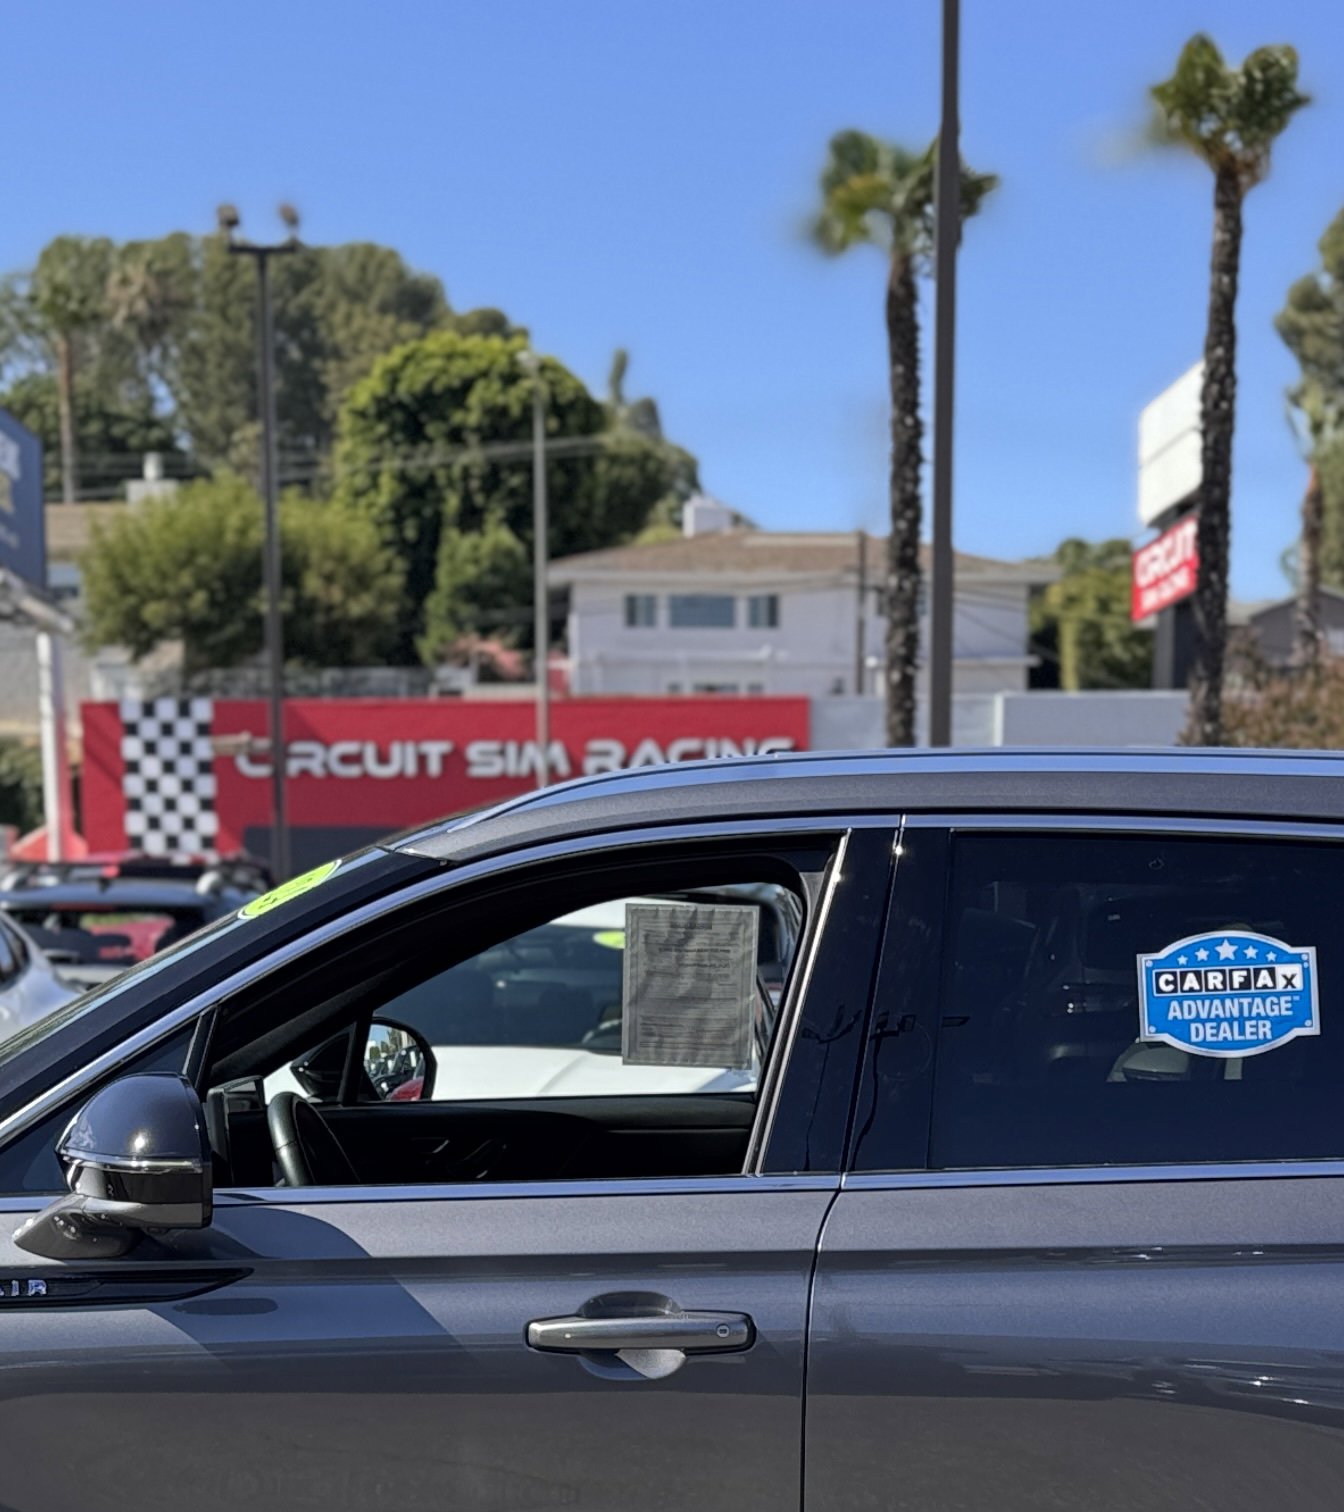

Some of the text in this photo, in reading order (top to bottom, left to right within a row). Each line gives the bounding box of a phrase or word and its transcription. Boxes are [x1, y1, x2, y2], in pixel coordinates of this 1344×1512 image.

[233, 739, 453, 778] CRCUIT
[465, 740, 571, 778] SIM
[1156, 967, 1301, 994] CARFAX
[1167, 997, 1294, 1021] ADVANTAGE
[1190, 1019, 1273, 1043] DEALER
